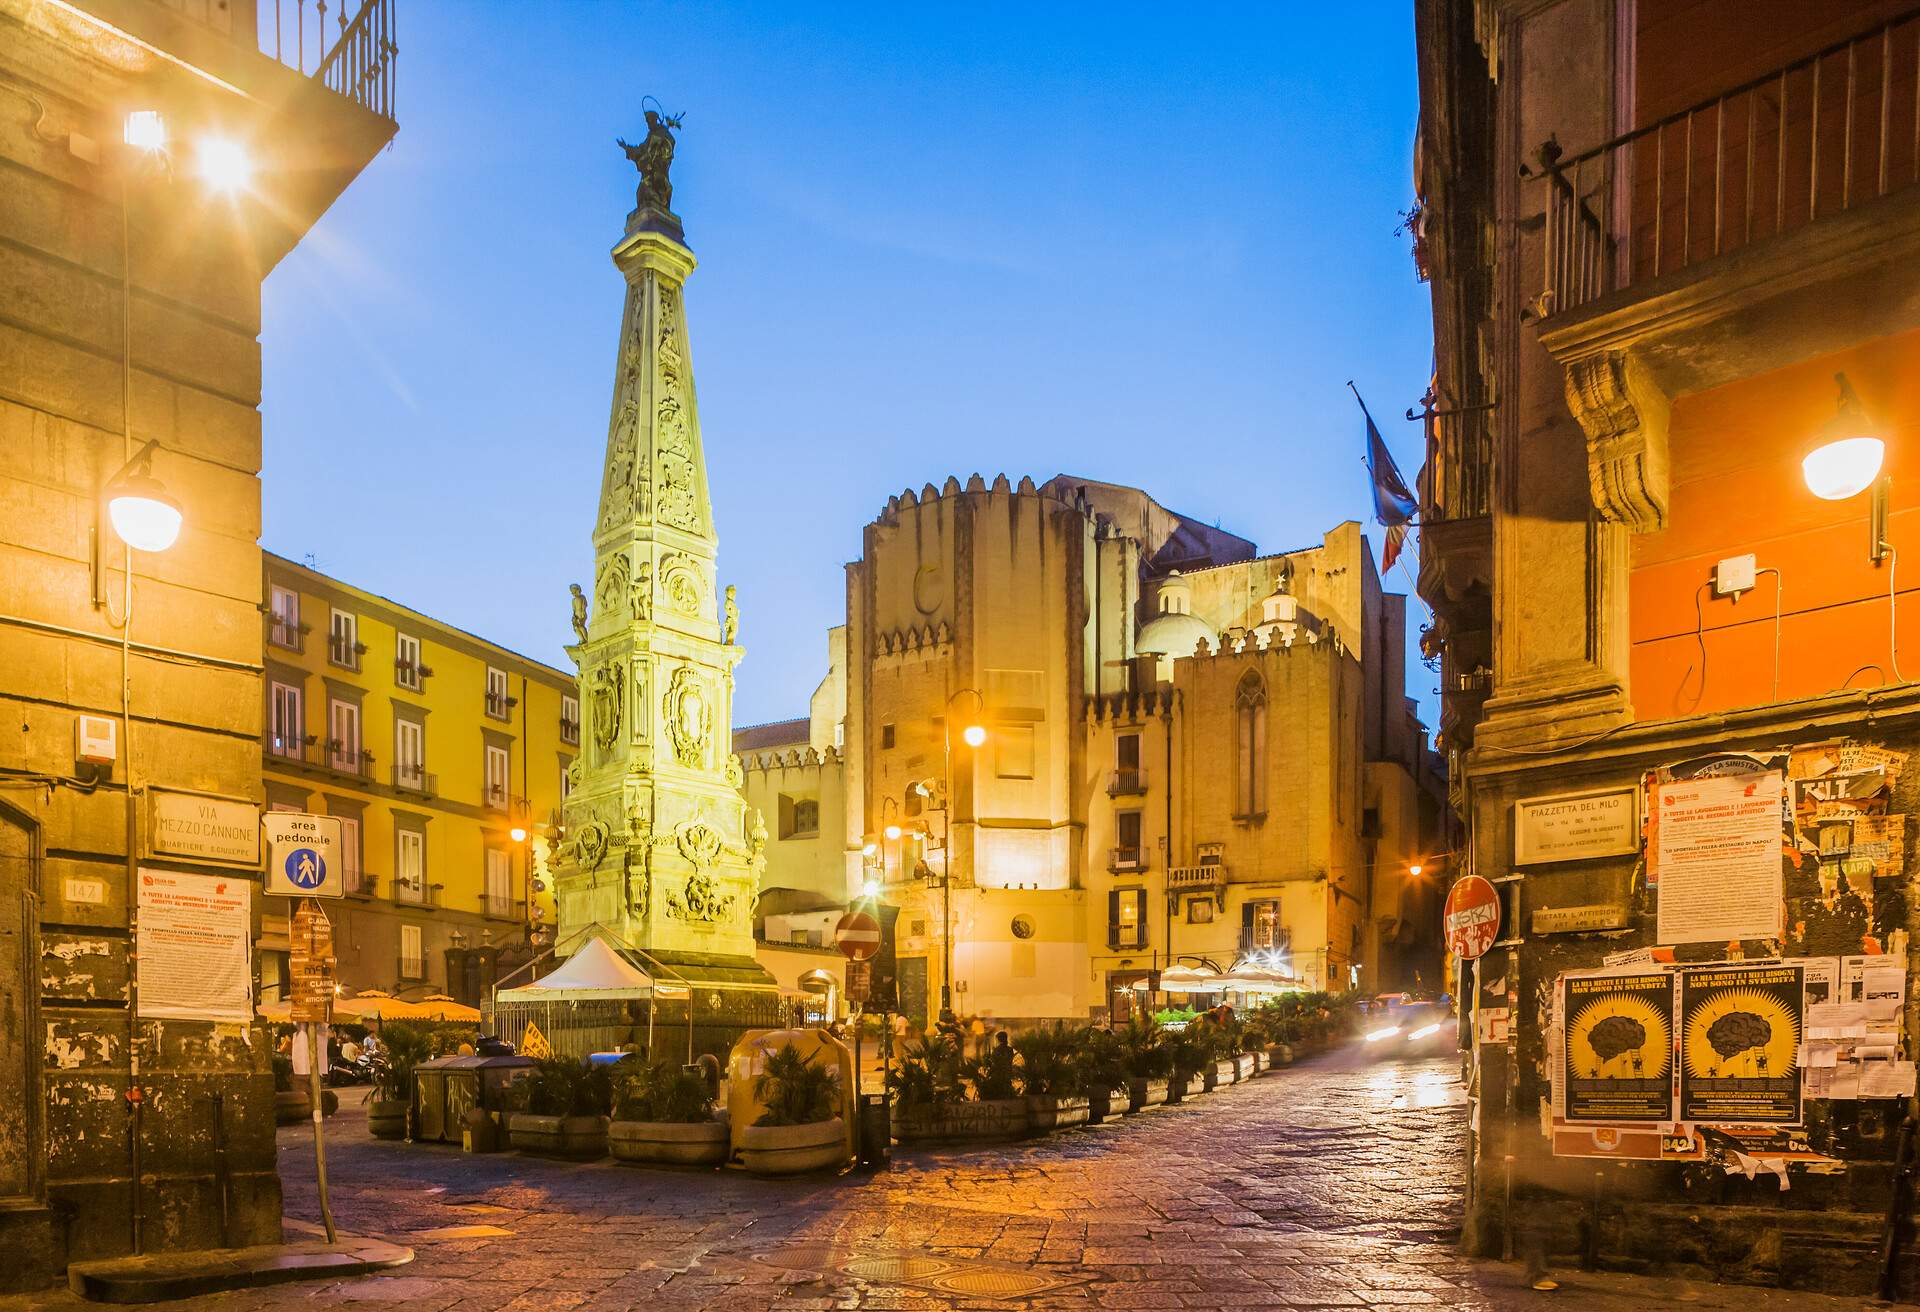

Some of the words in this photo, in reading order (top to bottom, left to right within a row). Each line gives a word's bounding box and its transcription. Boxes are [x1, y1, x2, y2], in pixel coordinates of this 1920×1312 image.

[1714, 762, 1725, 770] LA
[1725, 760, 1759, 772] SINISTRA
[198, 804, 218, 820] VIA
[1531, 805, 1577, 817] PIAZZETTA
[1580, 802, 1596, 812] DEL
[1599, 799, 1619, 808] MILO
[160, 818, 200, 836] MEZZO
[203, 824, 254, 842] CANNONE
[291, 821, 317, 831] area
[161, 839, 203, 851] QUARTIERE
[276, 832, 331, 846] pedonale
[1536, 912, 1568, 922] VIETATA
[1714, 973, 1737, 981] MENTE
[1765, 969, 1796, 978] BISOGNI
[1571, 986, 1589, 994] NON
[1589, 985, 1613, 993] SONO
[1613, 984, 1624, 992] IN
[1624, 982, 1667, 991] SVENDITA
[1689, 981, 1708, 989] NON
[1709, 979, 1734, 988] SONO
[1748, 975, 1796, 986] SVENDITA
